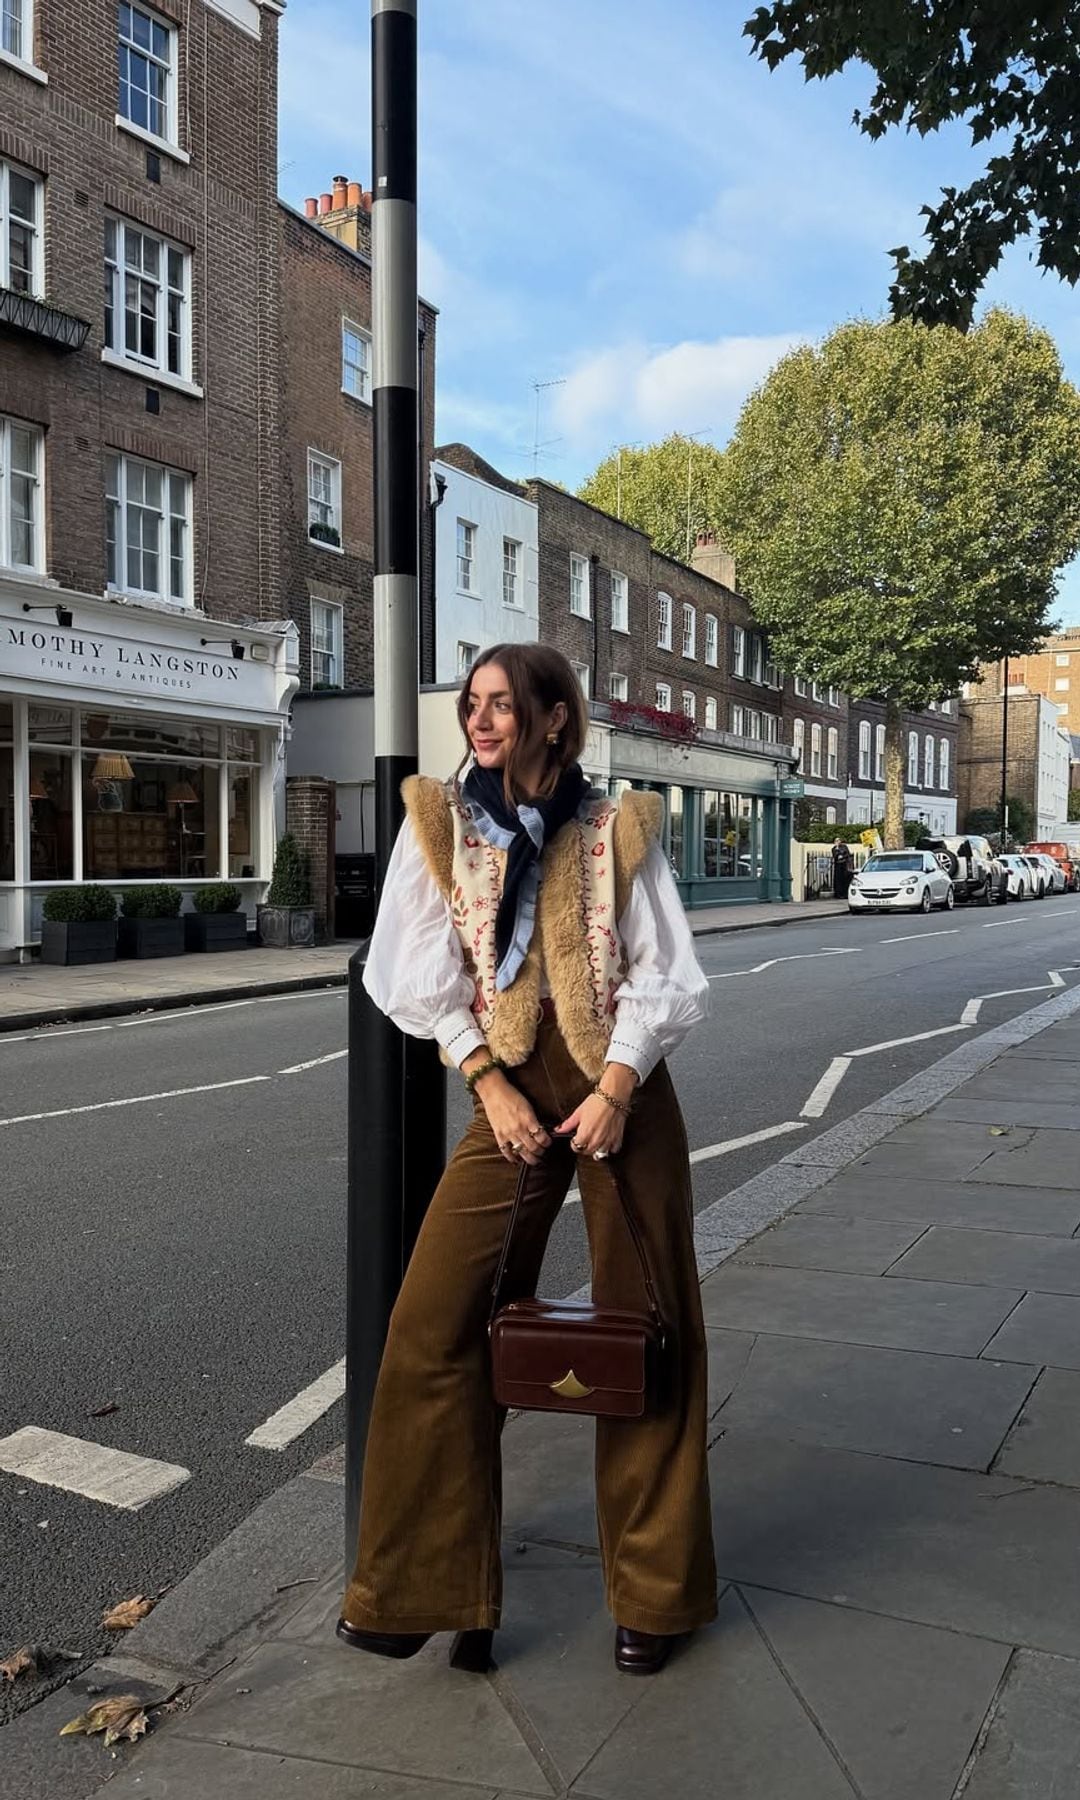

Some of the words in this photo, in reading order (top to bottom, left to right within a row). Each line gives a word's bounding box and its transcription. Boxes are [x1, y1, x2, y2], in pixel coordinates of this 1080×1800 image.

[0, 627, 104, 658] MOTHY
[117, 647, 239, 680] LANGSTON
[41, 657, 72, 671] FINE
[82, 664, 106, 676] ART
[115, 669, 122, 678] &
[131, 672, 192, 689] ANTIQUES
